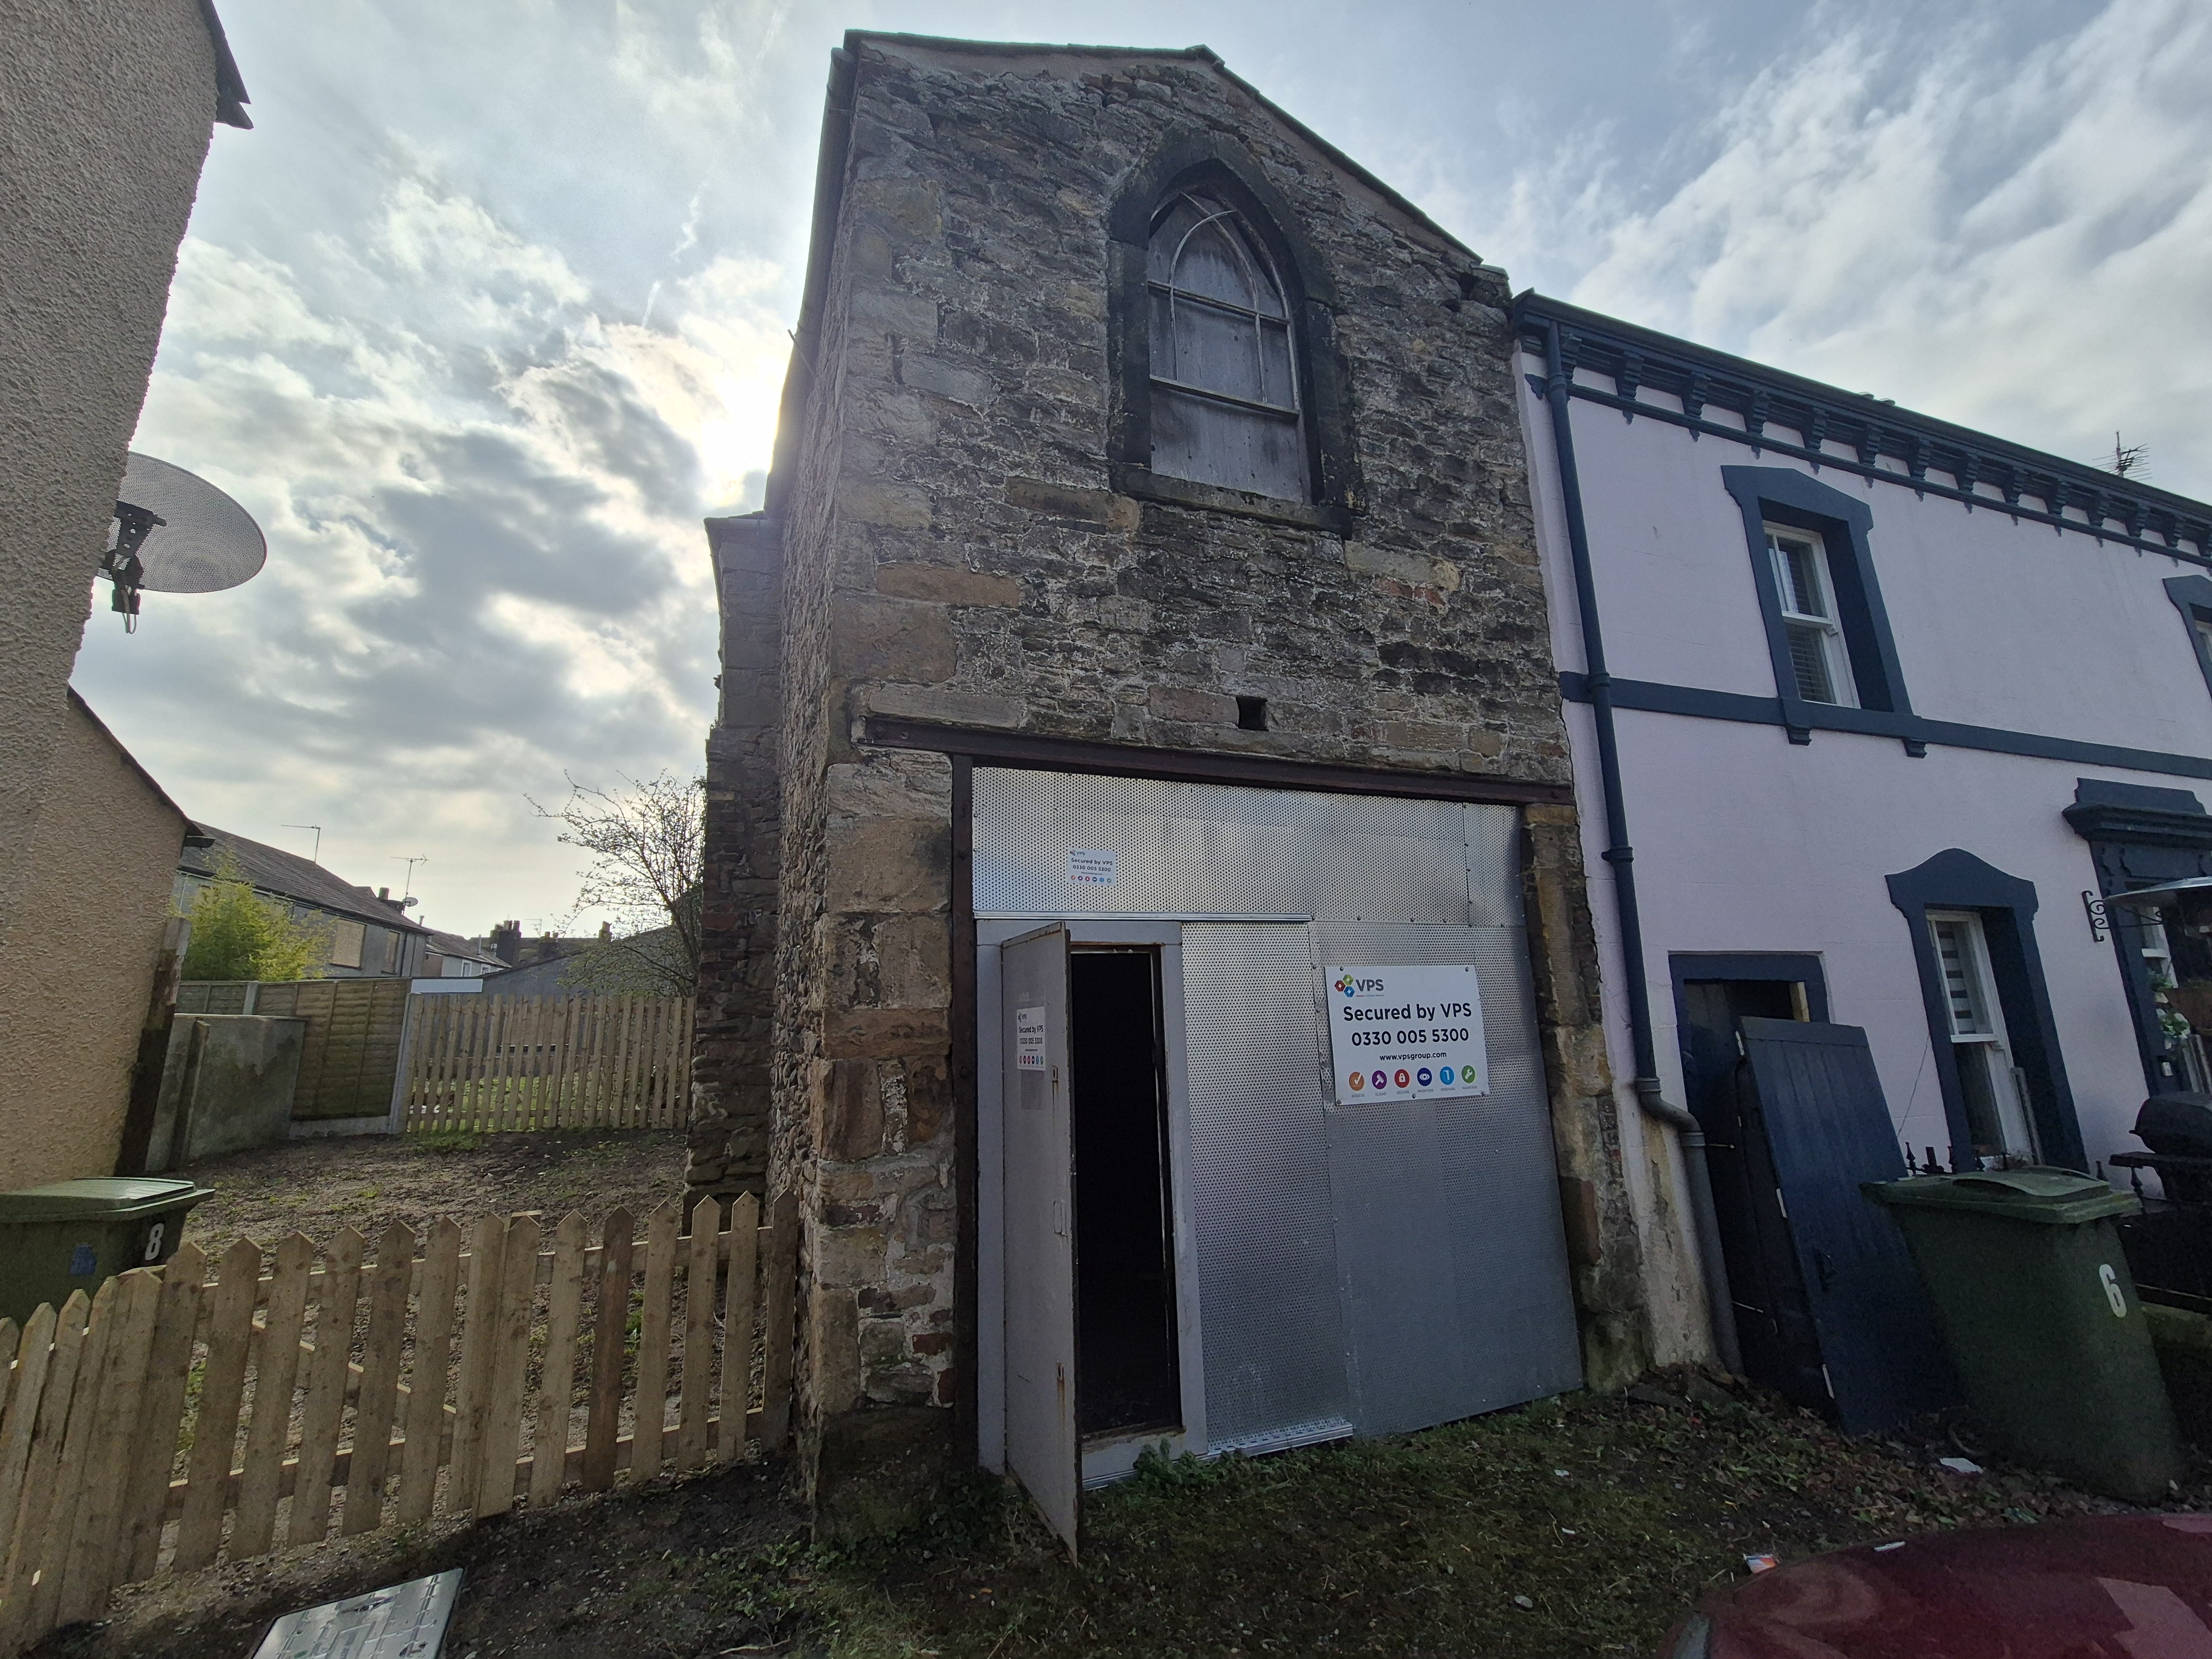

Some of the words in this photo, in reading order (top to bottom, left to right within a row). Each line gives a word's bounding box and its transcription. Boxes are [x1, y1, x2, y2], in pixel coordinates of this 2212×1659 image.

[1355, 979, 1384, 992] VPS
[1343, 1004, 1411, 1021] Secured
[1416, 1004, 1435, 1021] by
[1440, 1003, 1472, 1018] VPS
[1032, 1026, 1036, 1034] by
[1352, 1031, 1391, 1046] 0330
[1397, 1029, 1427, 1044] 005
[1432, 1027, 1469, 1042] 5300
[1379, 1051, 1447, 1061] www.vpsgroup.com
[145, 1223, 164, 1261] 8
[2099, 1264, 2127, 1318] 6
